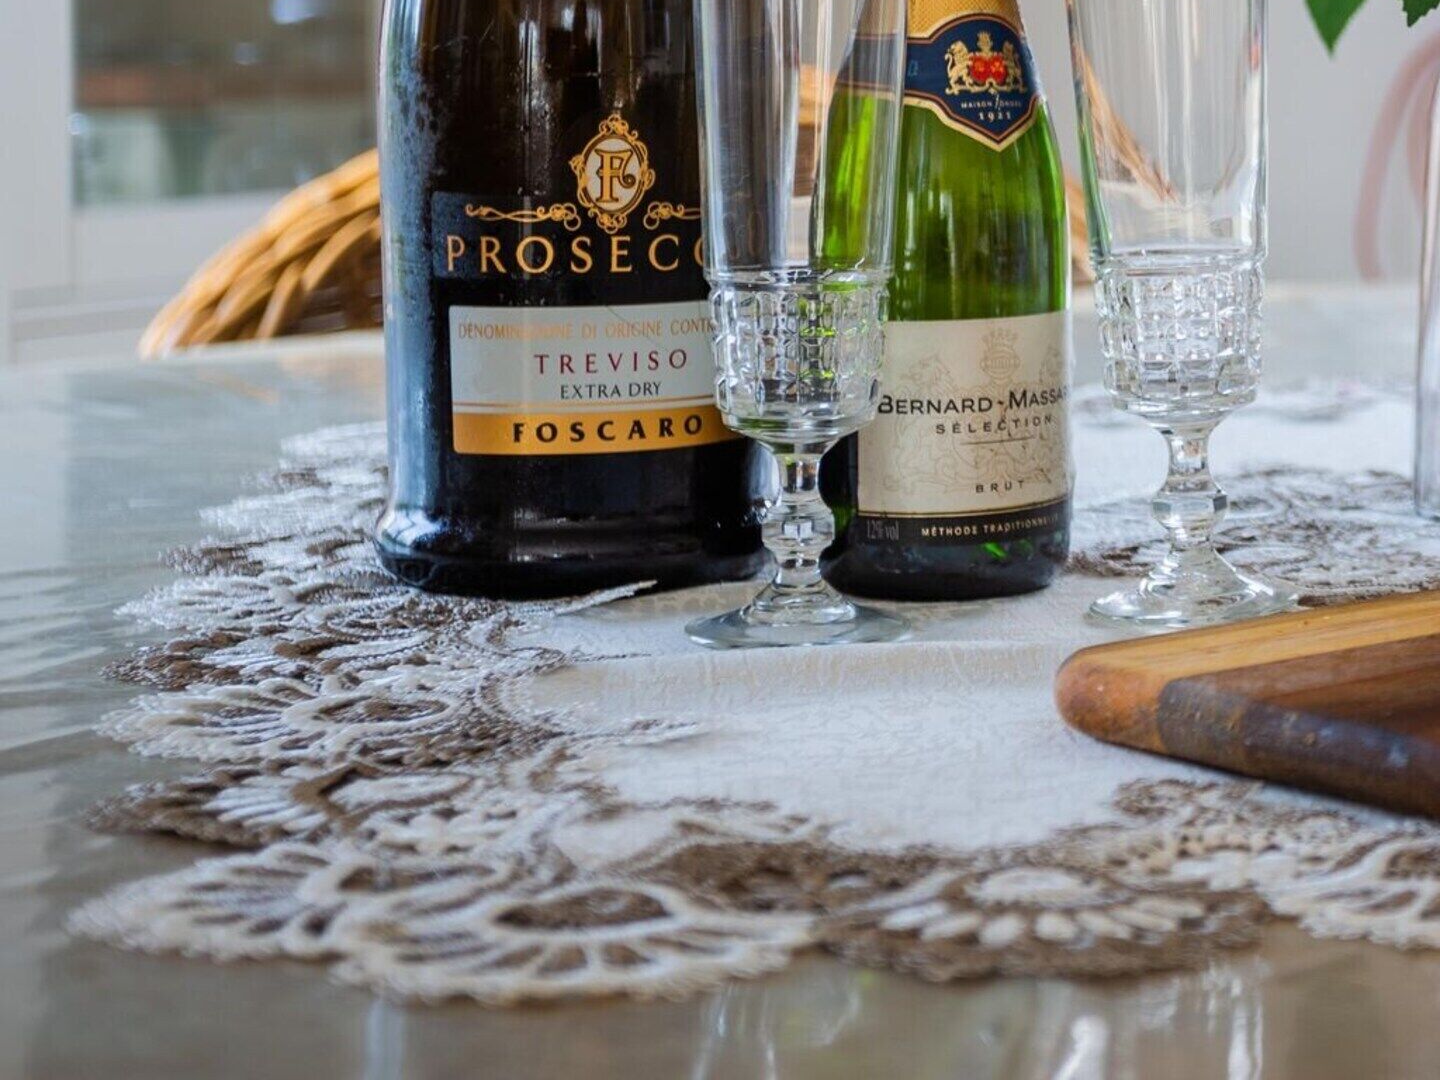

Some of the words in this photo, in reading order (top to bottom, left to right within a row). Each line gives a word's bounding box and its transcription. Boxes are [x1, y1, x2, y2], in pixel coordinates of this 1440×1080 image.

[582, 323, 597, 340] DI
[605, 319, 662, 338] ORIGINE
[534, 348, 687, 374] TREVISO
[561, 383, 620, 400] EXTRA
[629, 381, 662, 397] DRY
[513, 414, 703, 443] FOSCARO
[936, 413, 1051, 435] SÉLECTION
[976, 479, 1024, 493] BRUT
[921, 524, 977, 537] MÉTHODE
